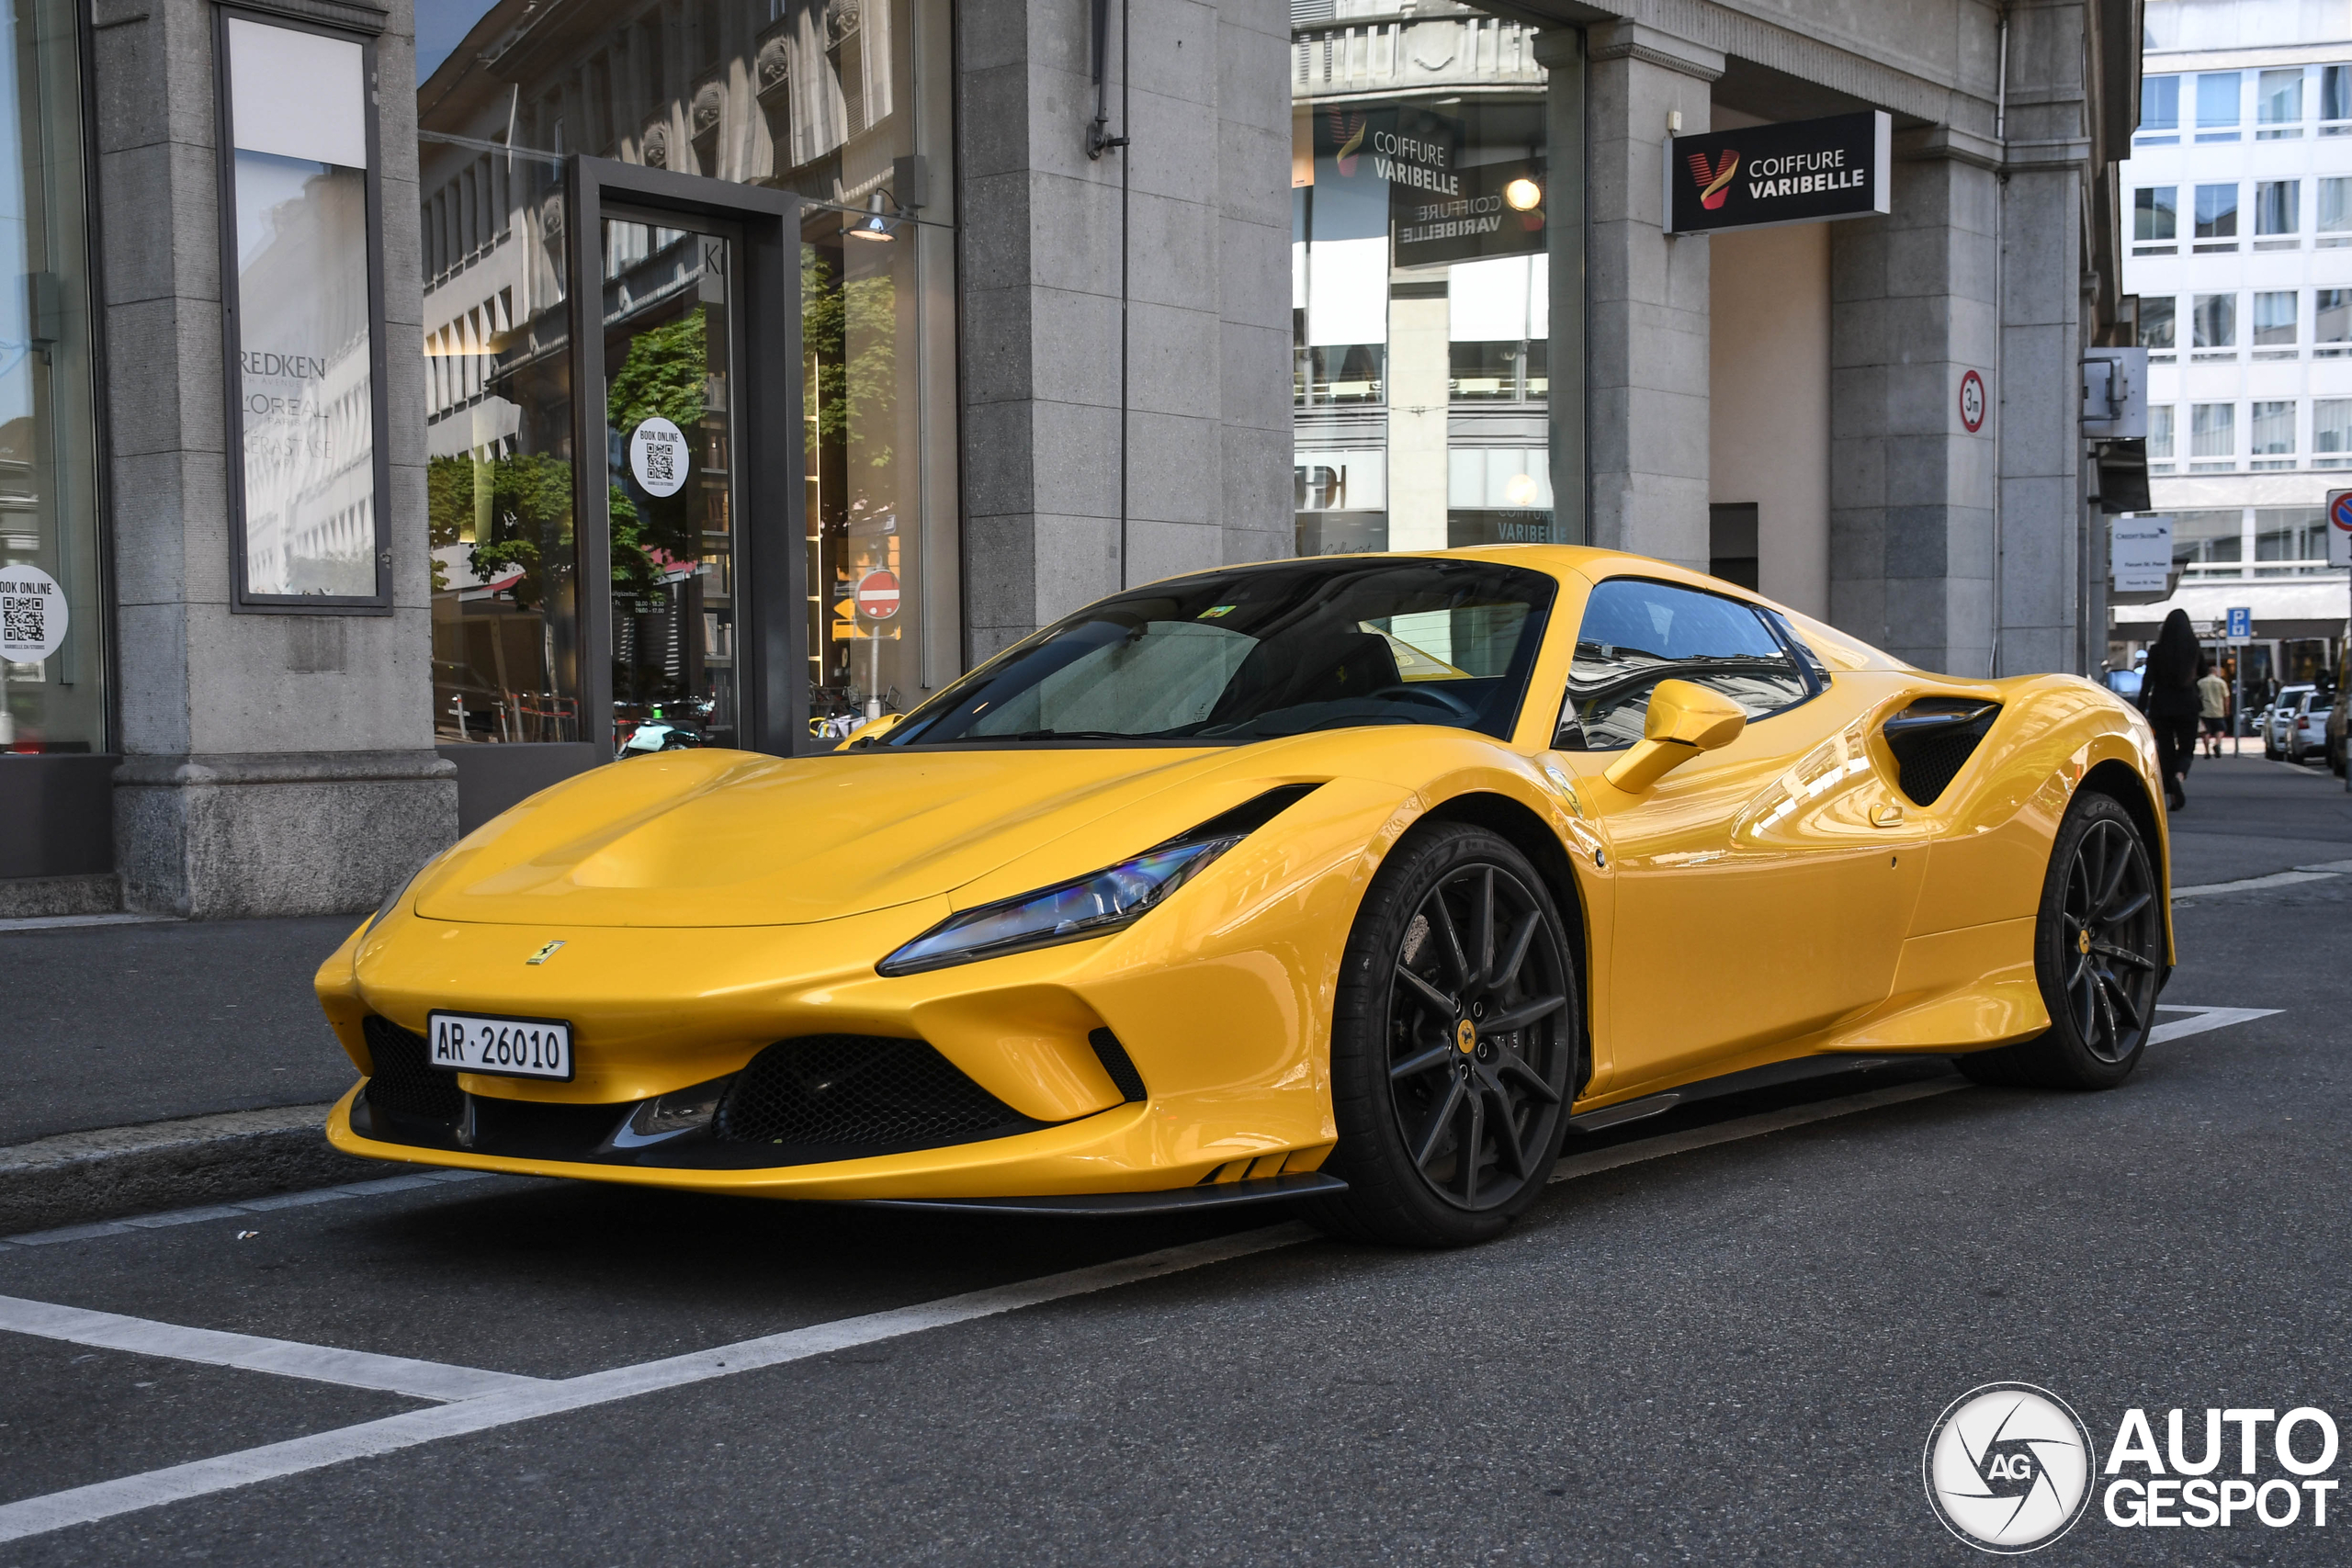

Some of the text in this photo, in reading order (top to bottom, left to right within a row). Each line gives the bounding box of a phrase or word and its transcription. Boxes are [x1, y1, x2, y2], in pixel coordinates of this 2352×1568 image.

[1374, 131, 1444, 167] COIFFURE
[1748, 149, 1845, 178] COIFFURE
[1374, 157, 1459, 197] VARIBELLE
[1748, 169, 1865, 199] VARIBELLE
[241, 351, 325, 381] REDKEN
[640, 430, 679, 443] BOOK ONLINE
[1498, 522, 1568, 545] VARIBELLE
[20, 581, 52, 595] ONLINE
